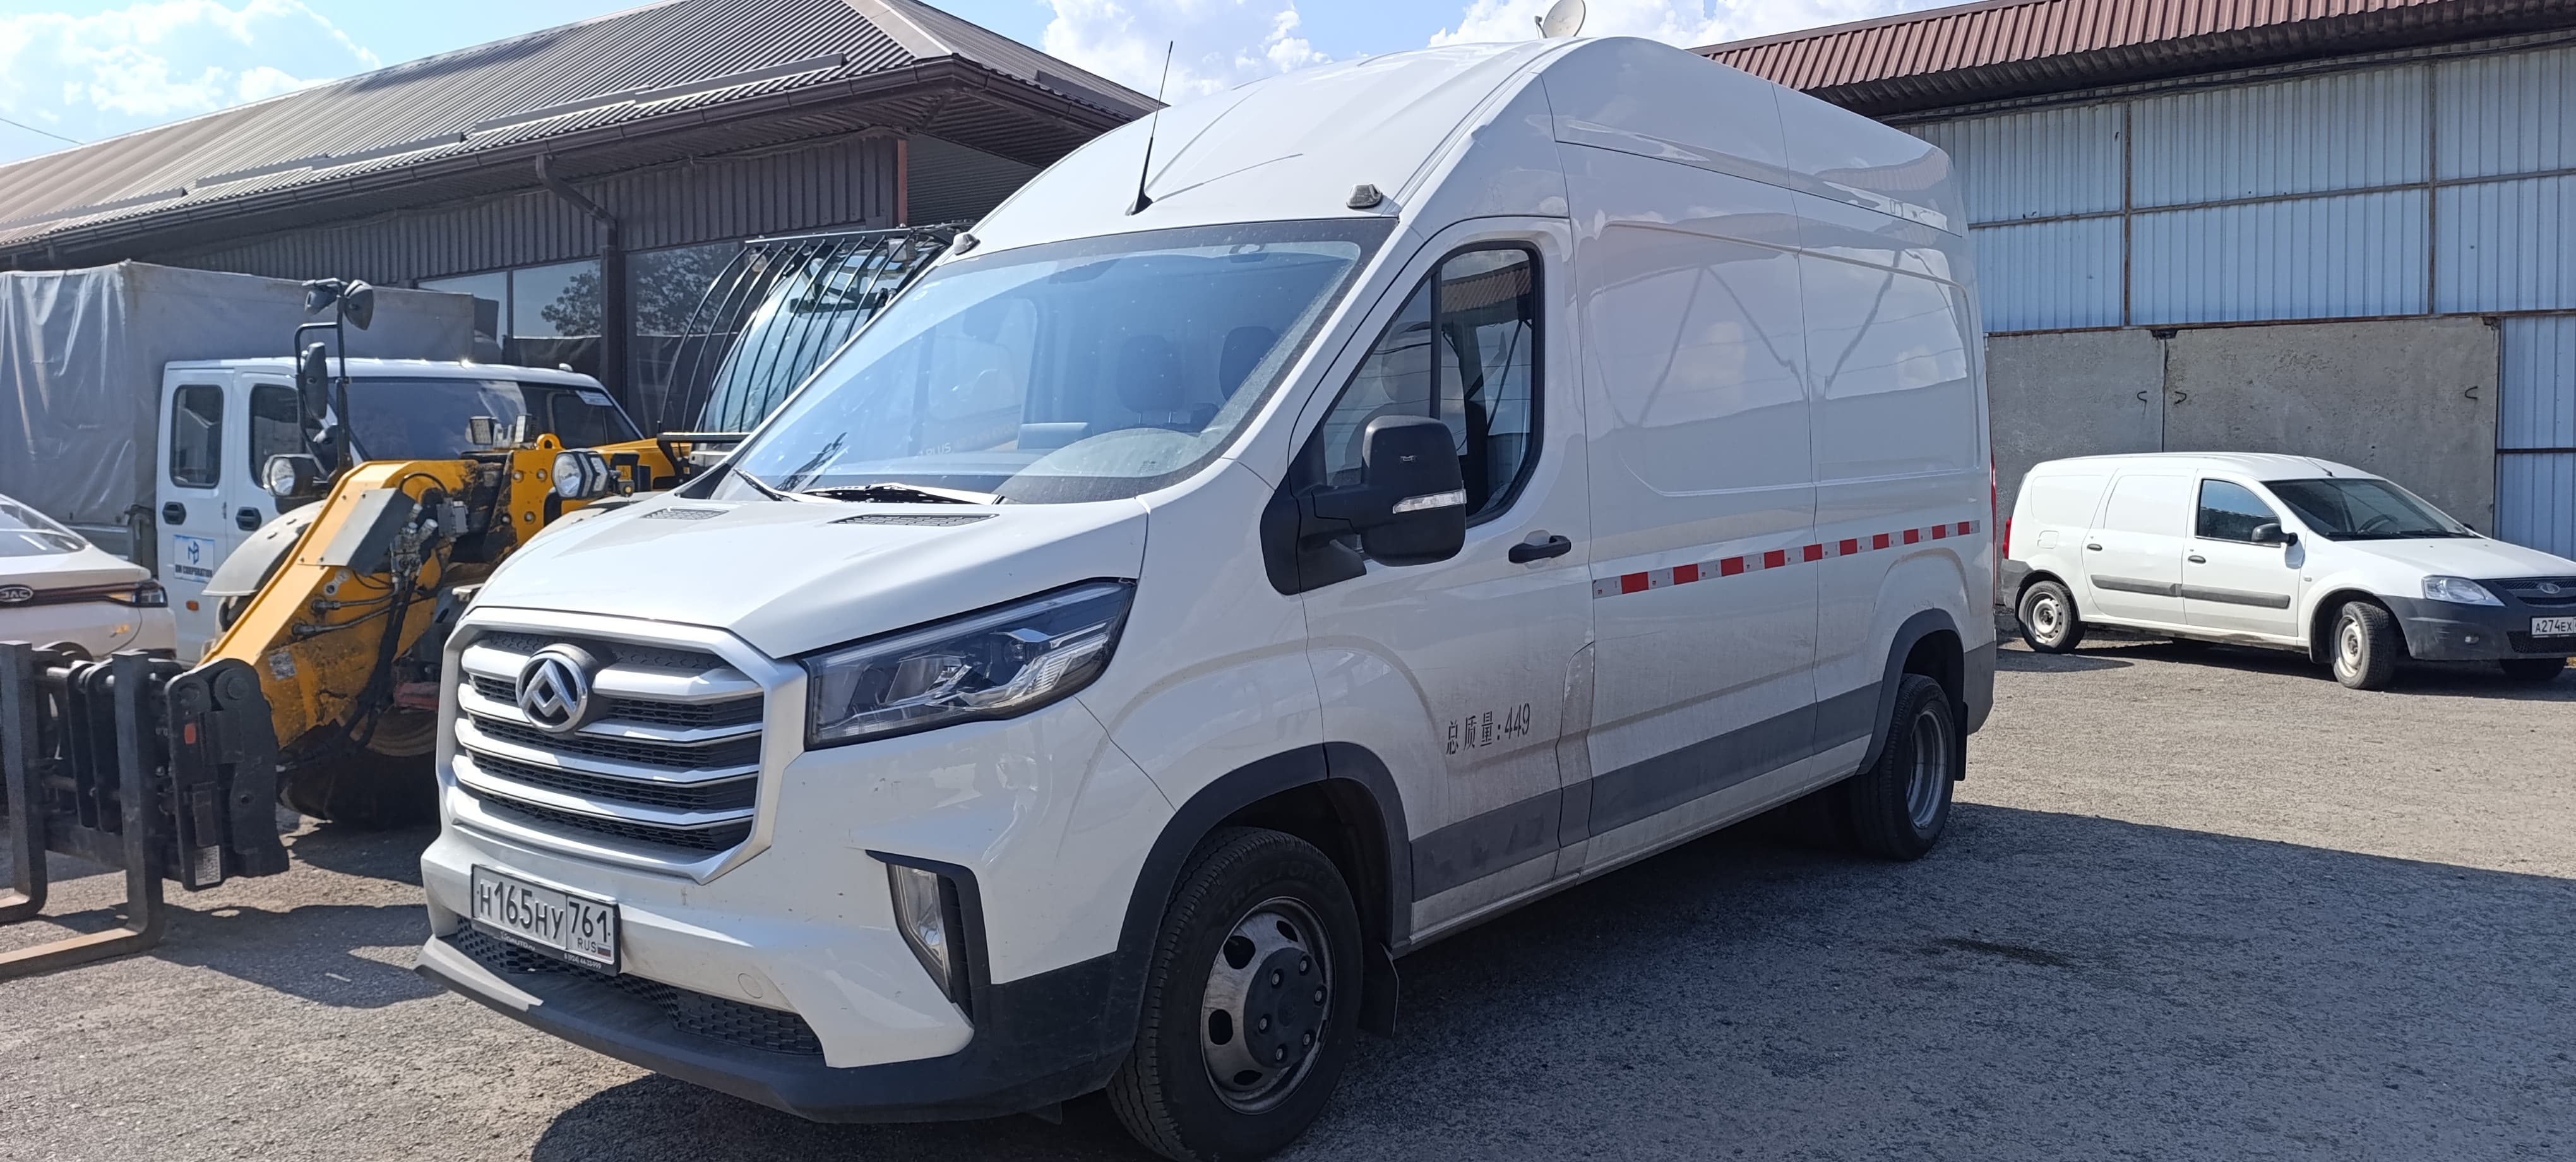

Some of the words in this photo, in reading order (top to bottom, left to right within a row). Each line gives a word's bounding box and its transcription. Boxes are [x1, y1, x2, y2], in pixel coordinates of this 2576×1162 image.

[0, 590, 28, 599] JAC
[569, 901, 607, 943] 761
[577, 937, 597, 954] RUS
